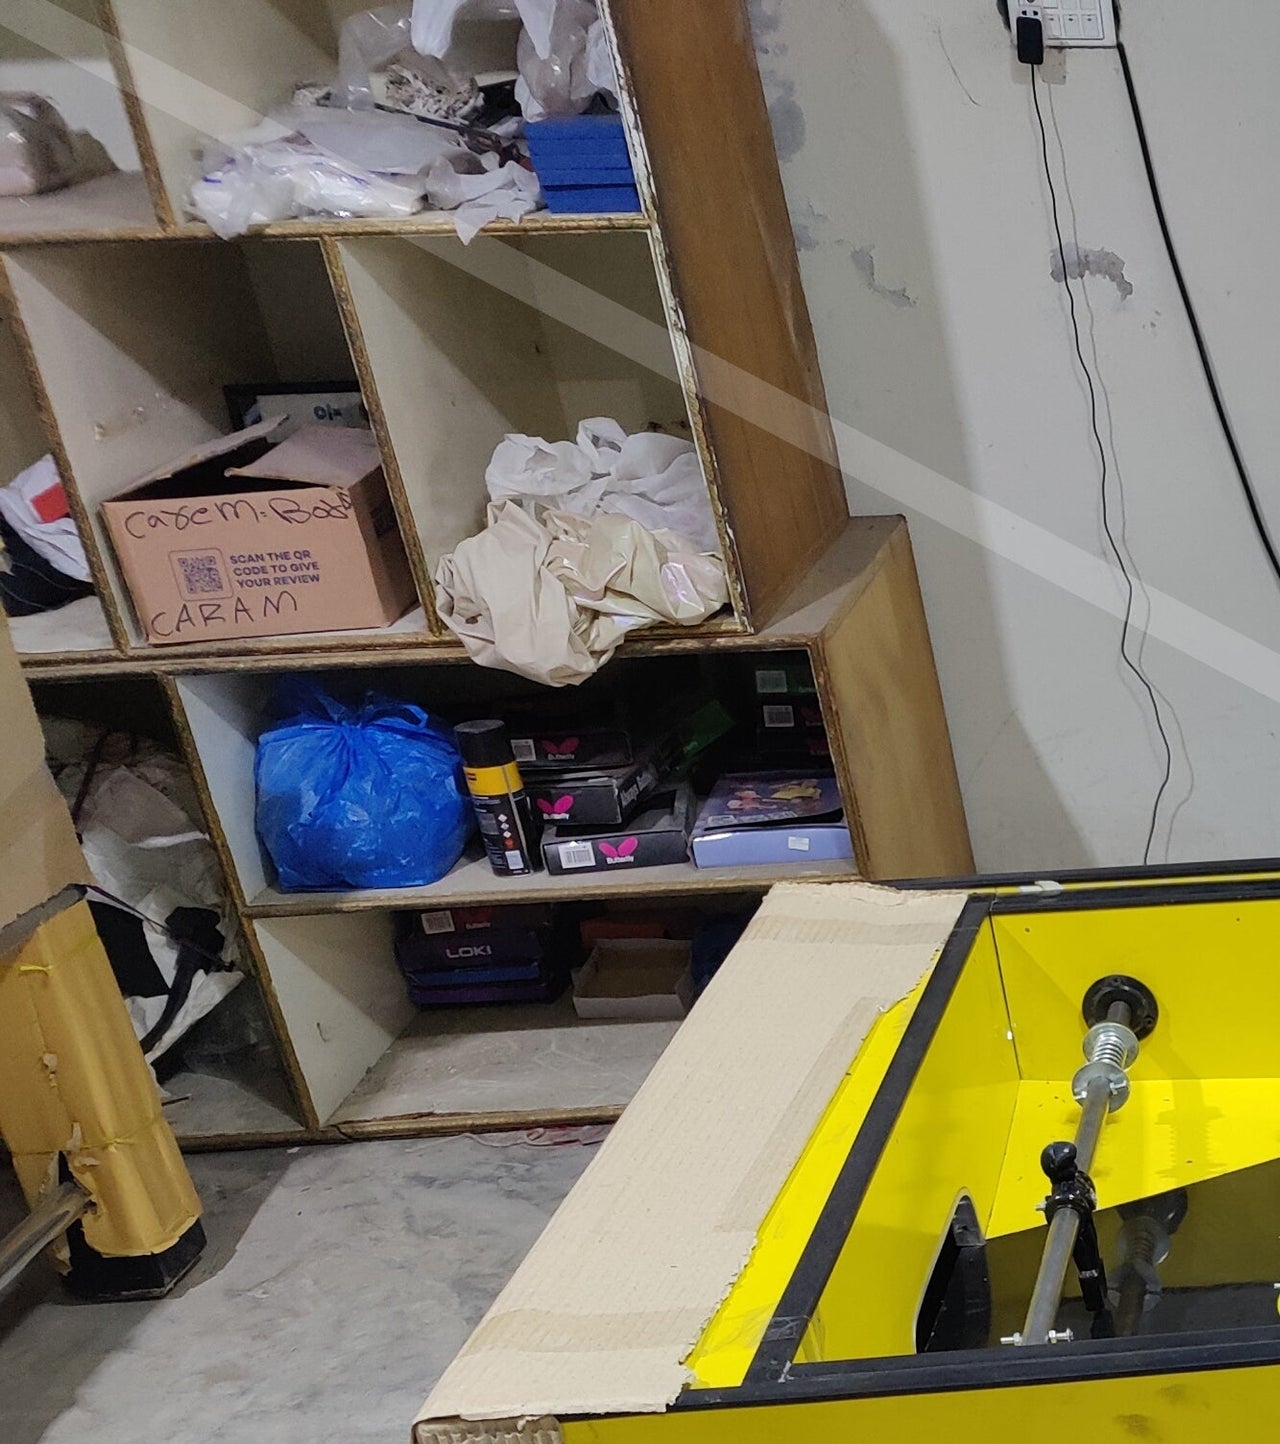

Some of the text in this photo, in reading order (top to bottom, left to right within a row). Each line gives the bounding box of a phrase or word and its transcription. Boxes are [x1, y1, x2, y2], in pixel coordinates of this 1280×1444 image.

[230, 549, 312, 565] SCAN THE QR
[233, 561, 320, 577] CODE TO GIVE
[236, 574, 320, 588] YOUR REVIEW
[445, 944, 493, 959] LOKI
